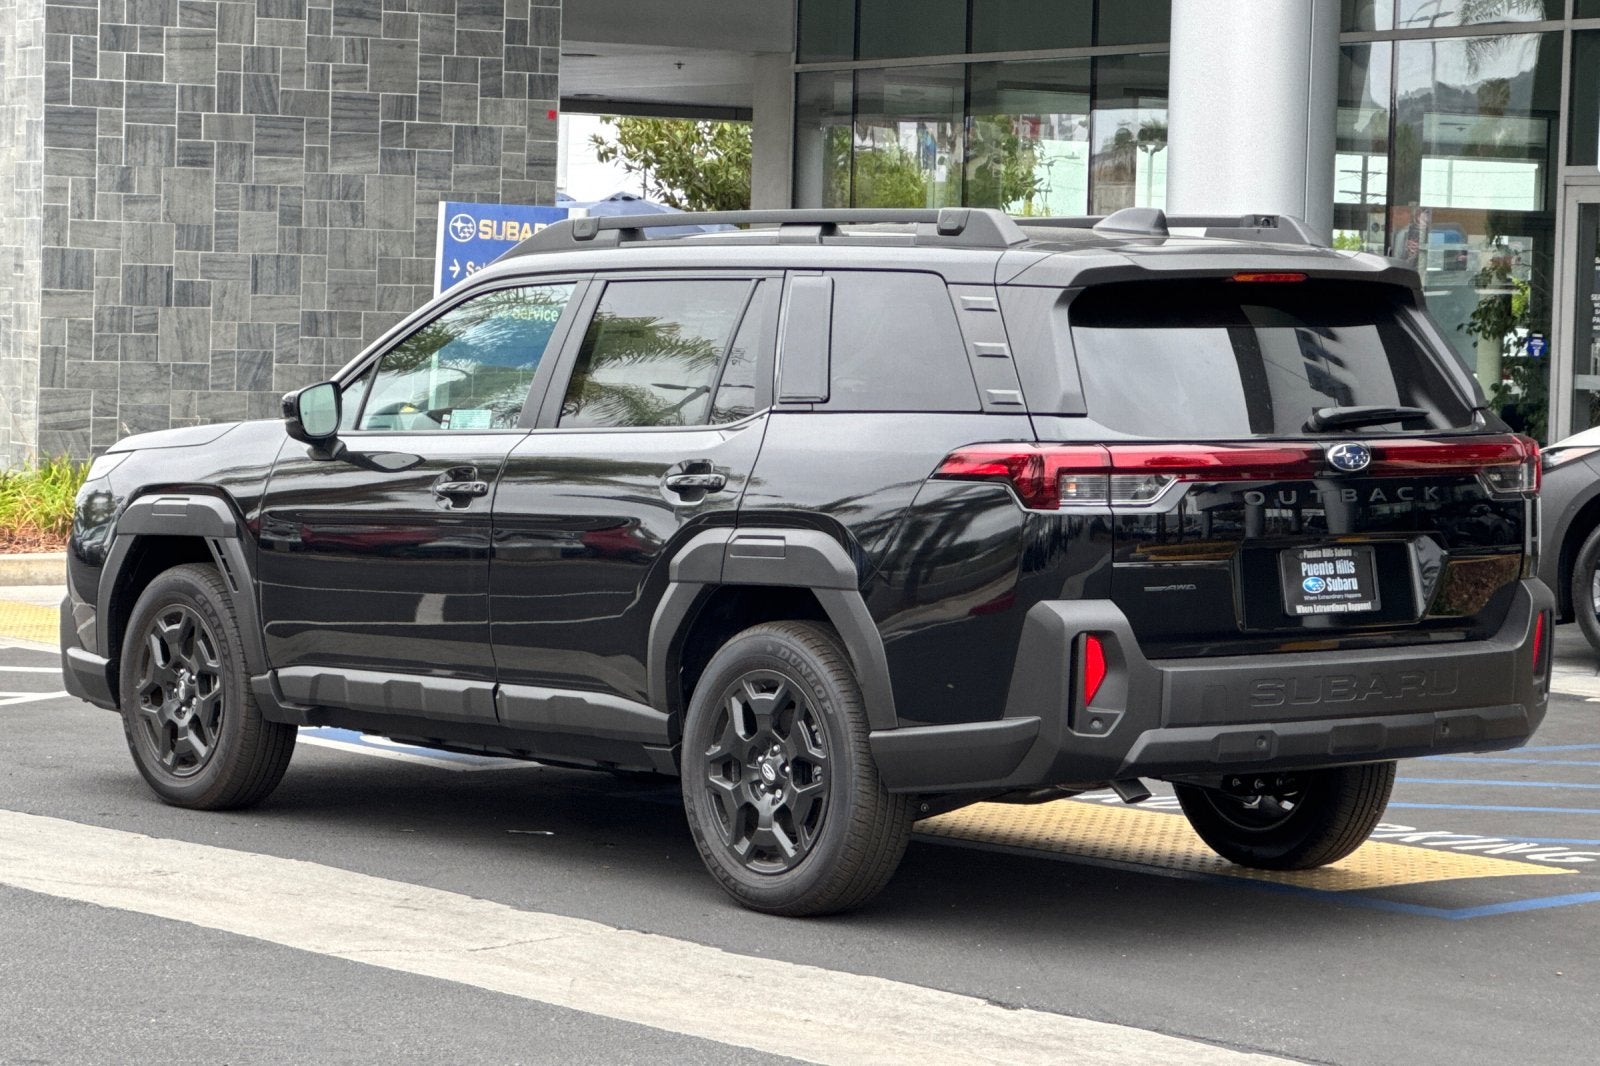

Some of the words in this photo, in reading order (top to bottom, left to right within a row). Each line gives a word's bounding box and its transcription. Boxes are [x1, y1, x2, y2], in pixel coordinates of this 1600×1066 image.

[478, 219, 549, 241] SUBA
[1244, 486, 1440, 506] OUTBACK
[1301, 561, 1334, 576] Puente
[1336, 559, 1355, 574] Hills
[1326, 577, 1358, 591] Subaru
[777, 646, 834, 714] DUNLOP
[1250, 669, 1459, 707] SUBARU
